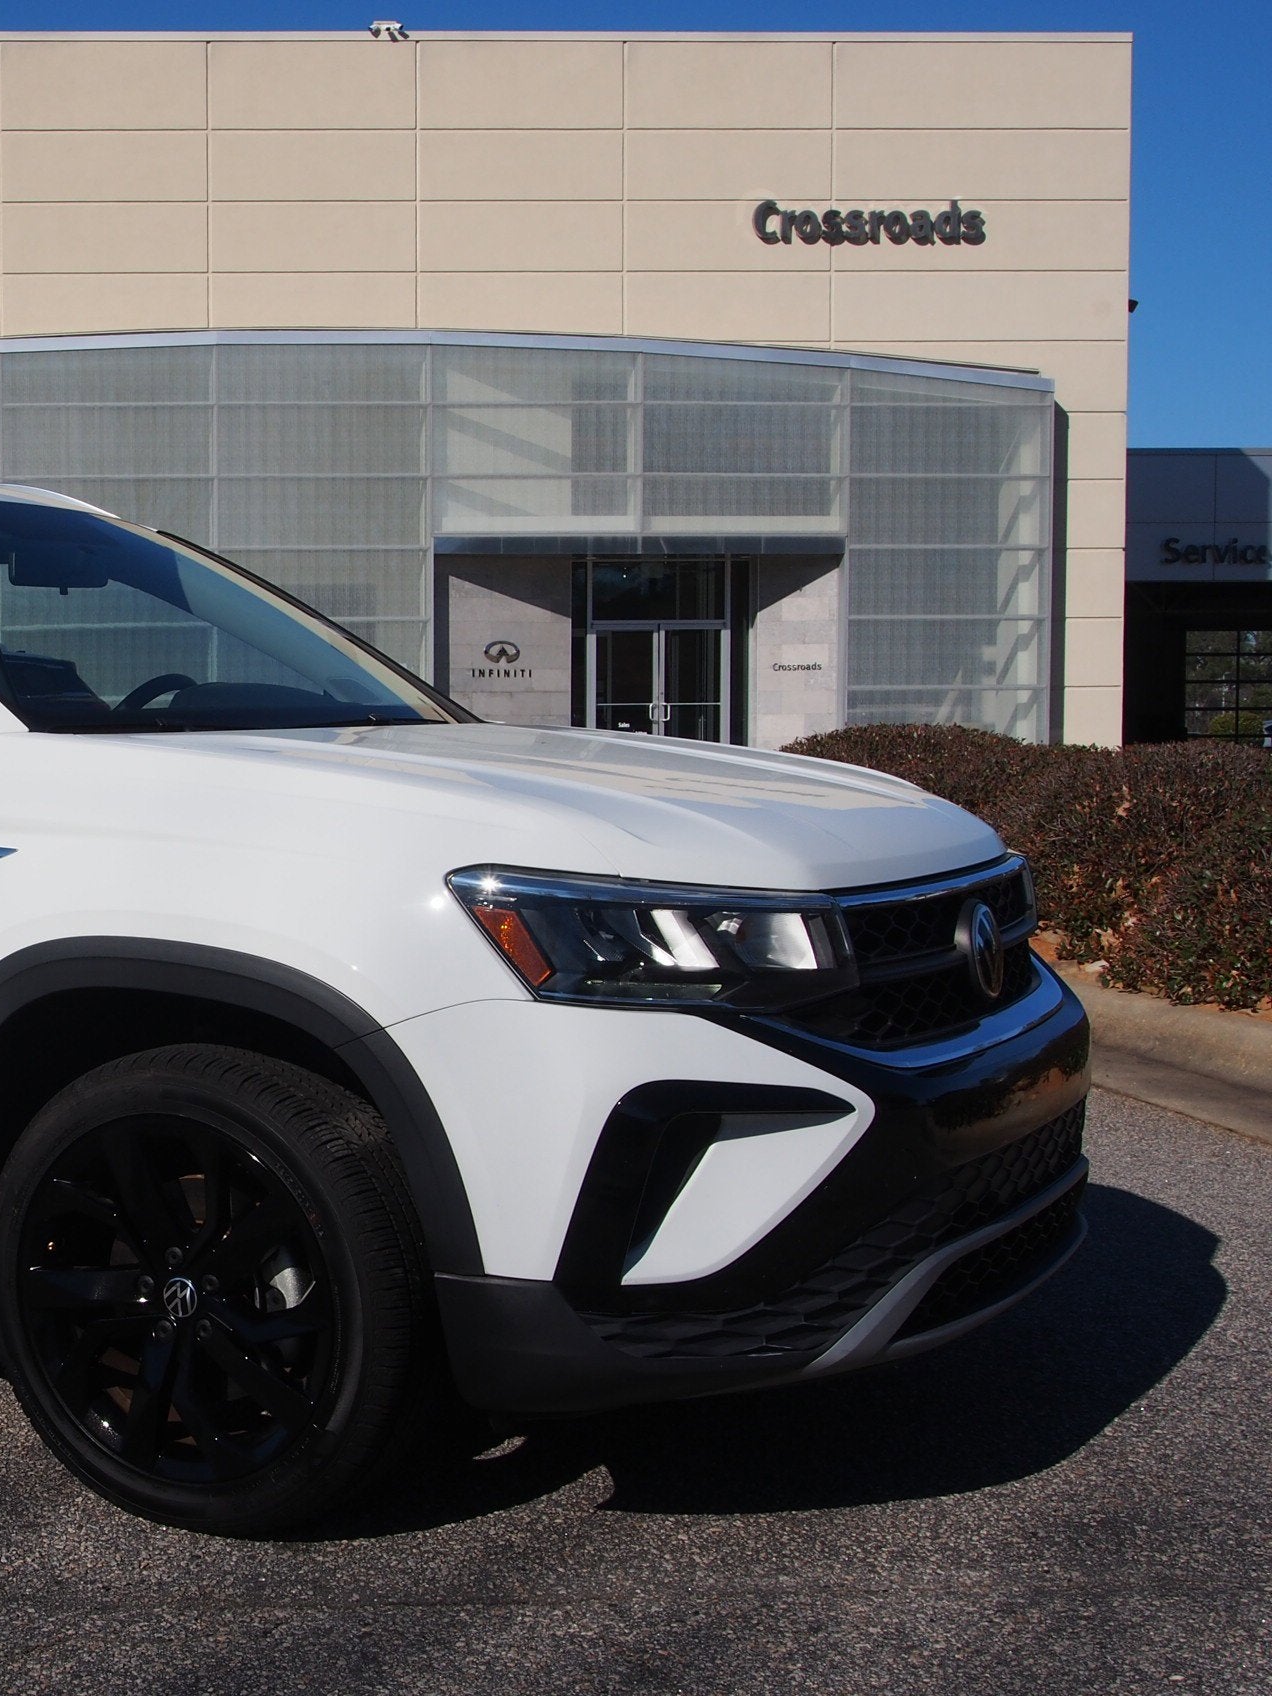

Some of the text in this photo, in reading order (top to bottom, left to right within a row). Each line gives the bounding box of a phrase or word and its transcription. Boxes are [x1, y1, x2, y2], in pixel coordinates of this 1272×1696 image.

[752, 199, 986, 246] Crossroads
[1160, 537, 1270, 564] Service
[471, 668, 532, 678] INFINITI
[772, 662, 822, 672] Crossroads
